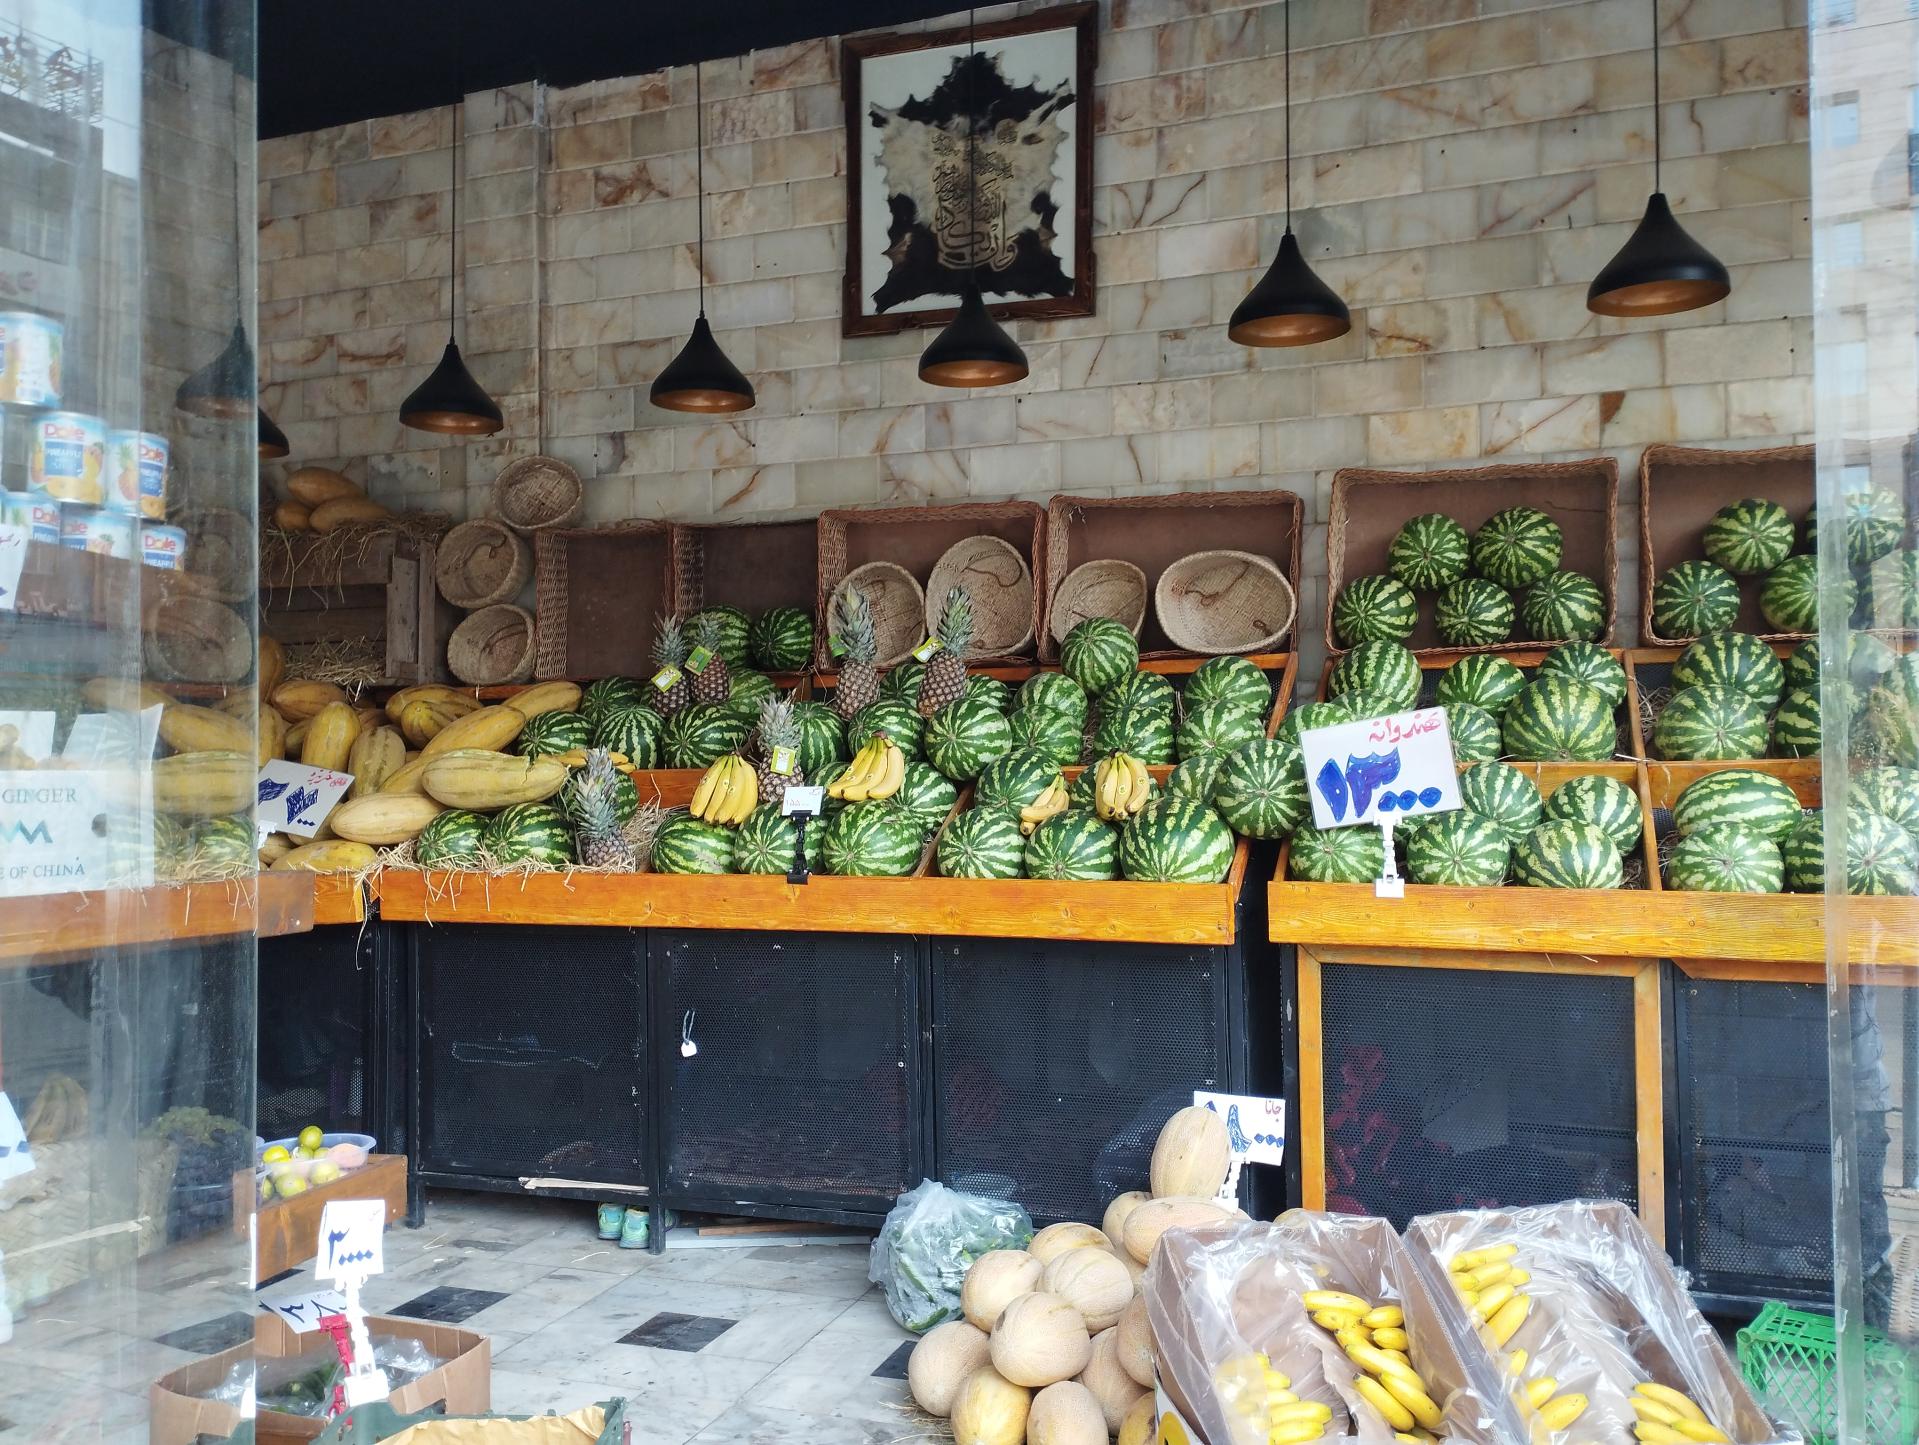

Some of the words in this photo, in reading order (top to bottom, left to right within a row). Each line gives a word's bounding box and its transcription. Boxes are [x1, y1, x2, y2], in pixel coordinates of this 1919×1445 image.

[44, 423, 86, 440] Dole
[144, 535, 177, 550] Dole
[2, 788, 78, 804] GINGER
[9, 865, 29, 880] OF
[33, 862, 86, 879] CHINA
